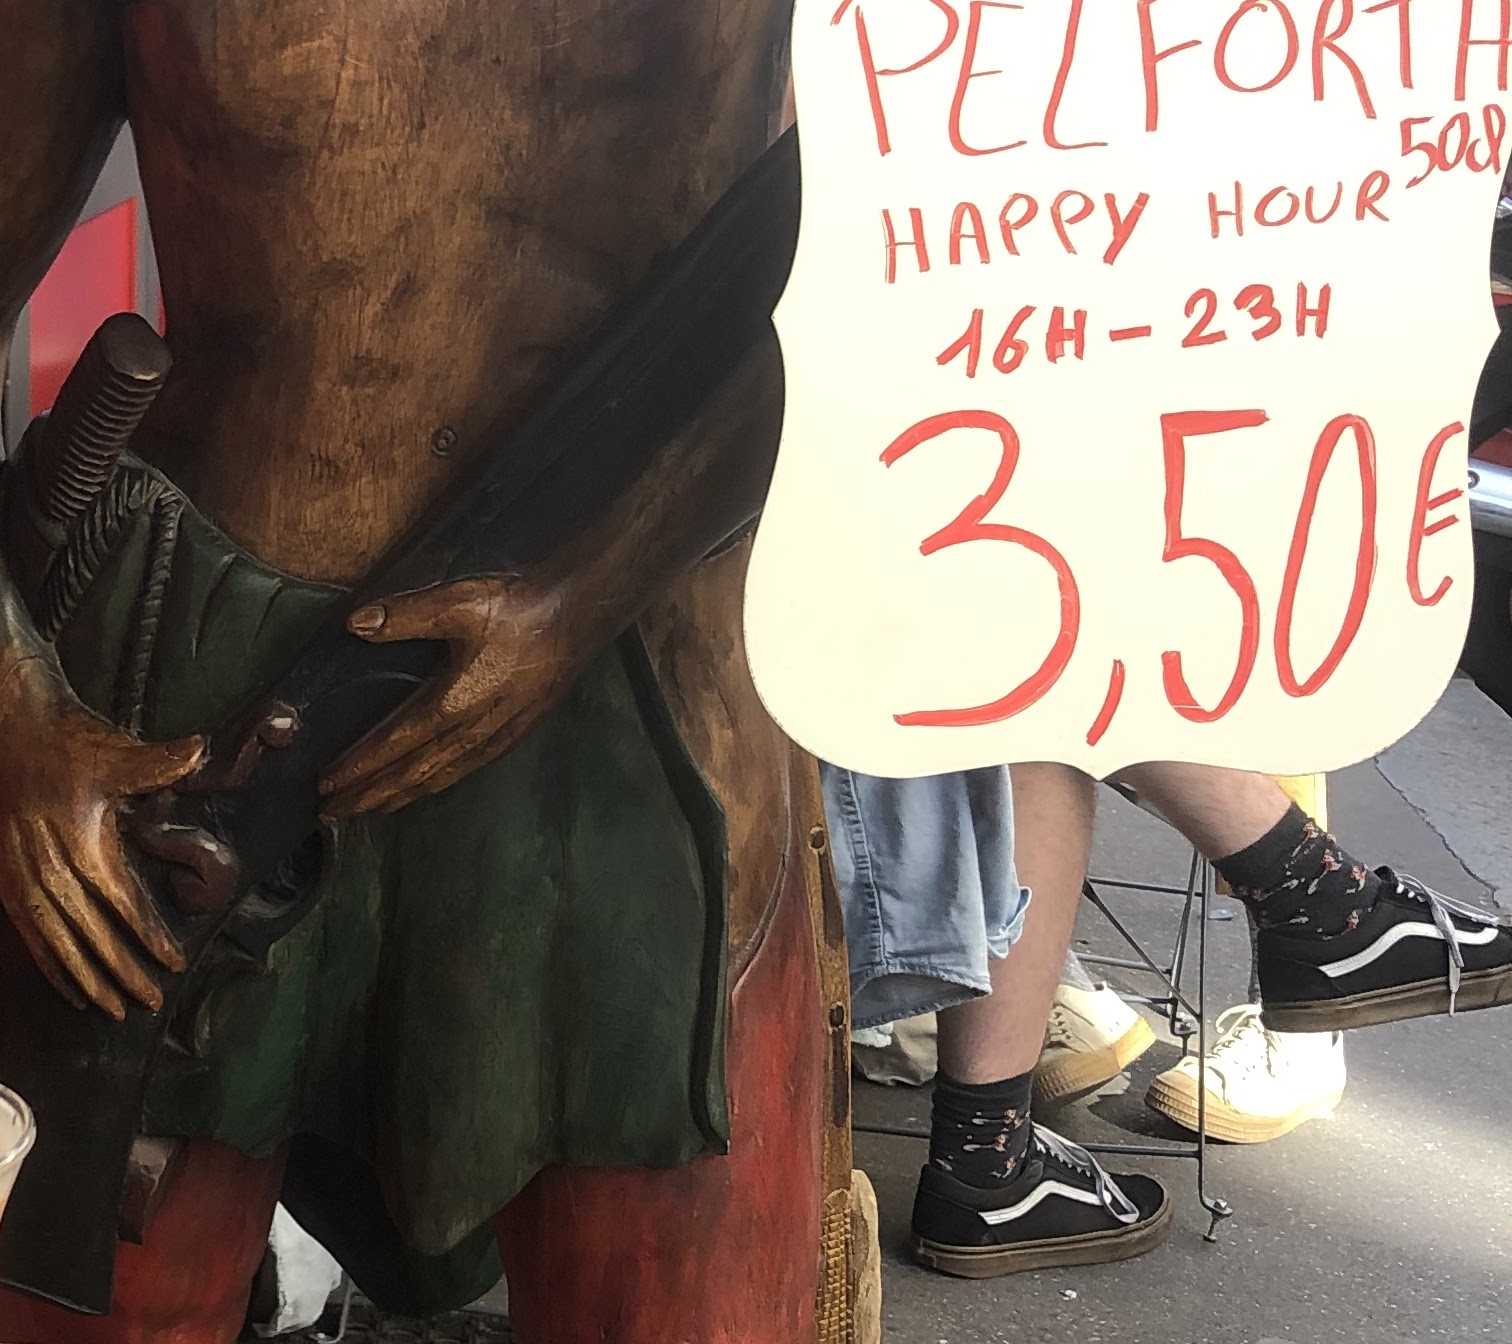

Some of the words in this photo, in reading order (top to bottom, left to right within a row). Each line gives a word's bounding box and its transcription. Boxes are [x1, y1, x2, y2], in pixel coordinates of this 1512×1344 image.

[880, 191, 1150, 284] HAPPY
[1208, 168, 1392, 240] HOUR
[935, 304, 1089, 378] 16H
[1180, 281, 1333, 349] 23H
